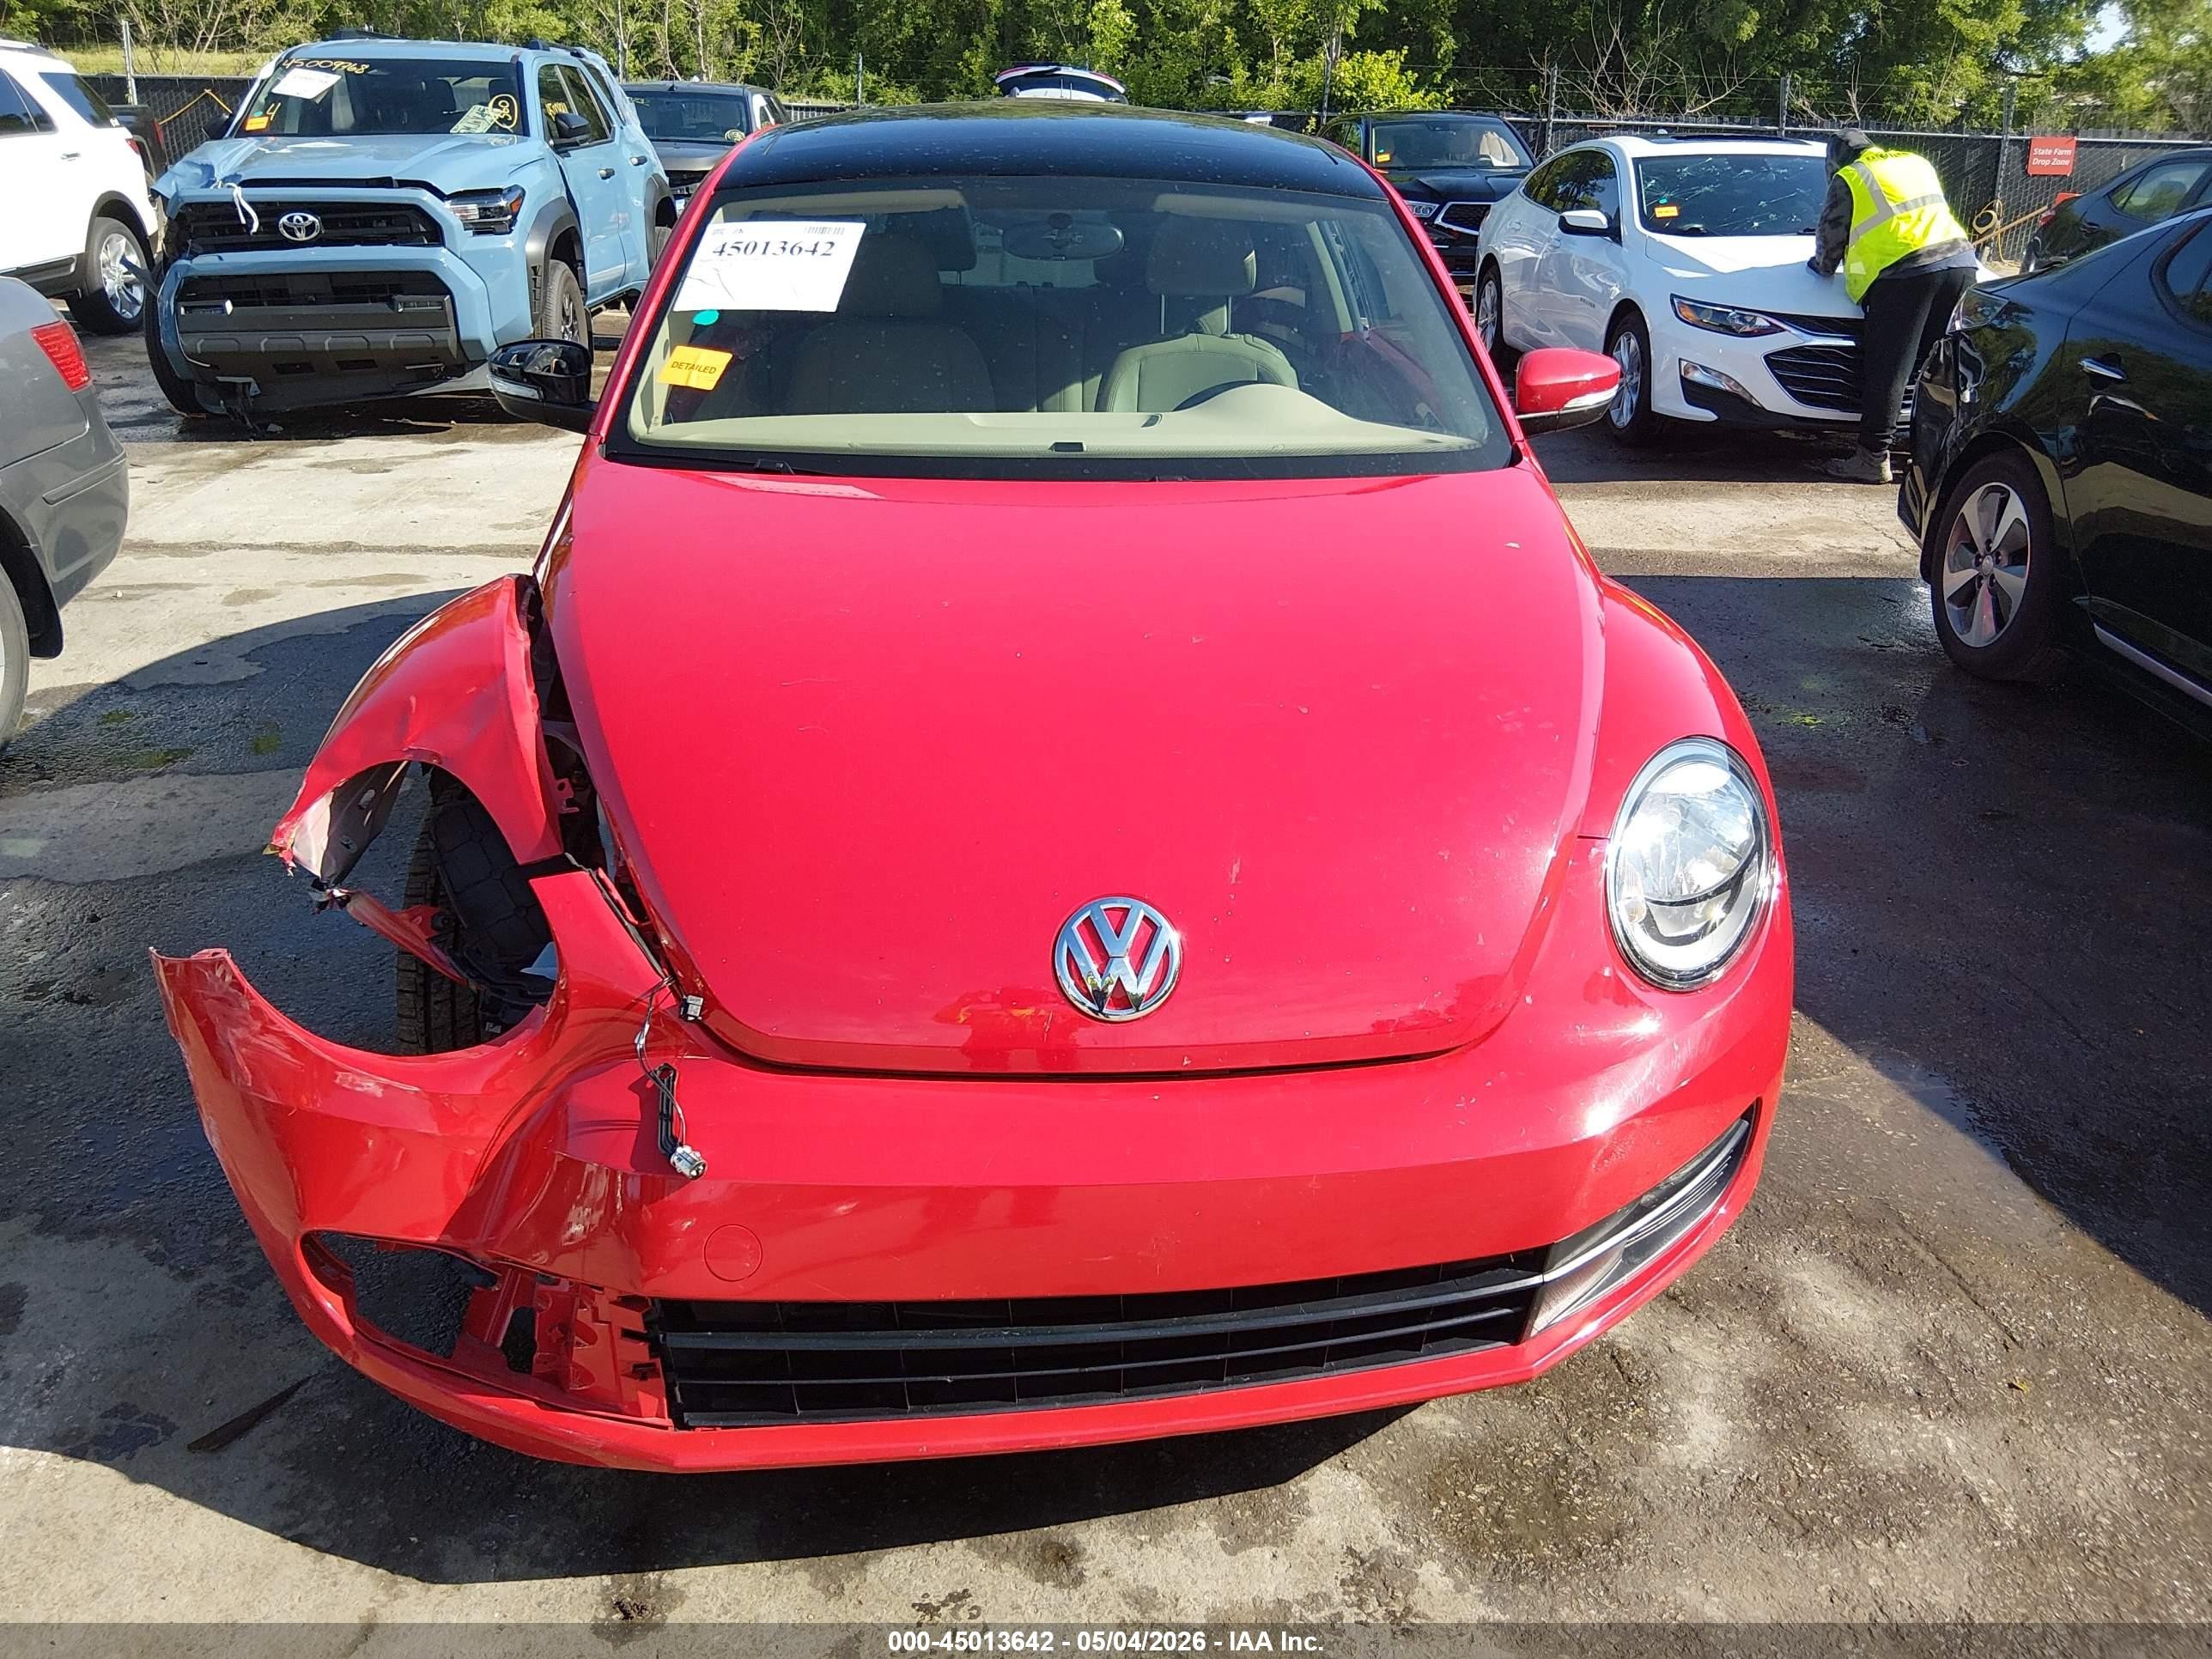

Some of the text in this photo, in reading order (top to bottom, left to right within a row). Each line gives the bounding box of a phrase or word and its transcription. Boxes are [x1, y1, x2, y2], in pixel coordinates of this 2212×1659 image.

[266, 102, 281, 121] 4
[2033, 157, 2070, 167] Drop Zone
[713, 240, 836, 256] 45013642
[671, 361, 717, 374] DETAILED
